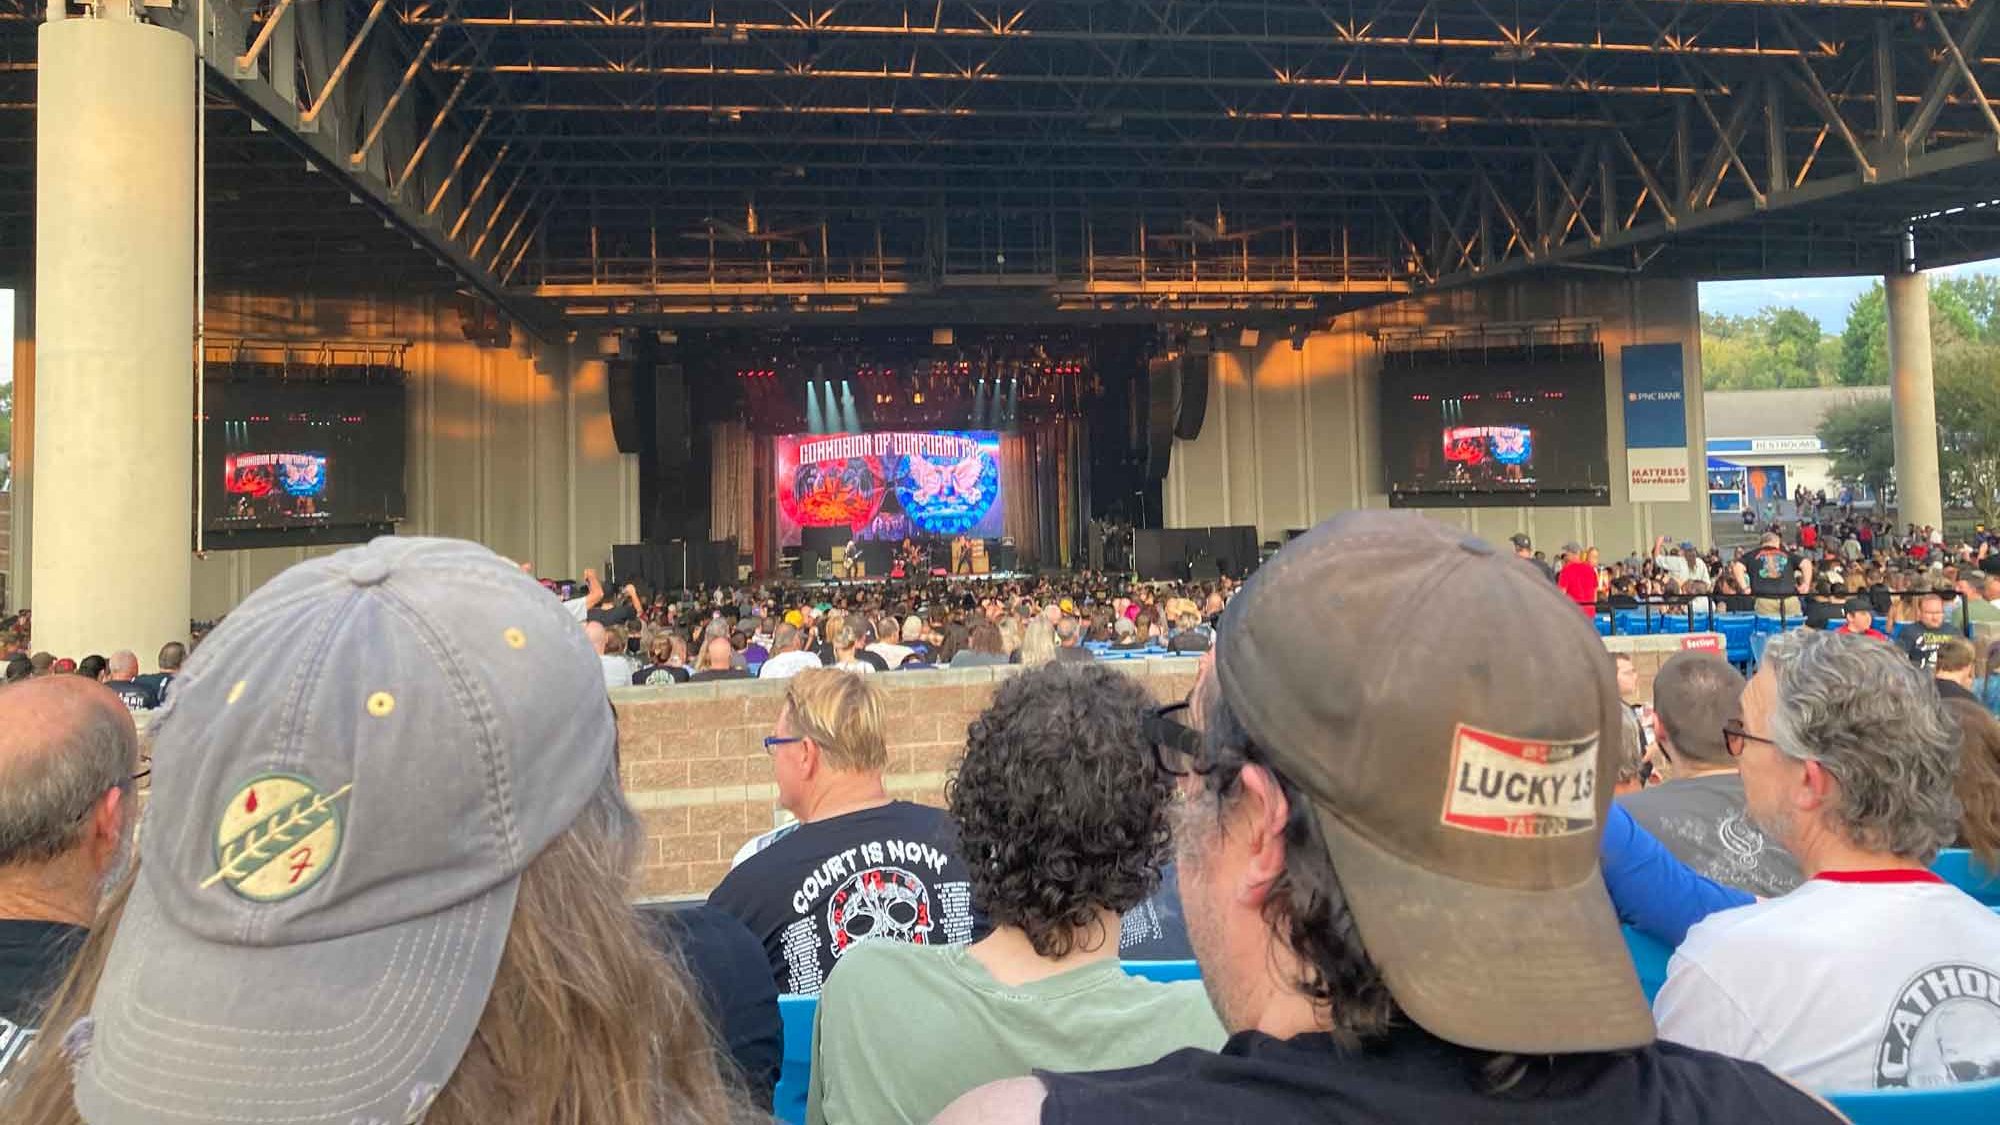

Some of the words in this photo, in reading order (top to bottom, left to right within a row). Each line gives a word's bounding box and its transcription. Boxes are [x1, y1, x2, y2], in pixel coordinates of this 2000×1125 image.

[1638, 392, 1657, 401] PNC
[1658, 392, 1681, 401] BANK
[874, 433, 890, 456] OF
[1631, 467, 1687, 476] MATTRESS
[1686, 638, 1715, 649] Section
[1458, 762, 1566, 805] LUCKY
[1571, 768, 1594, 801] 13
[793, 848, 857, 914] COURT
[861, 842, 884, 867] IS
[886, 840, 947, 874] NOW
